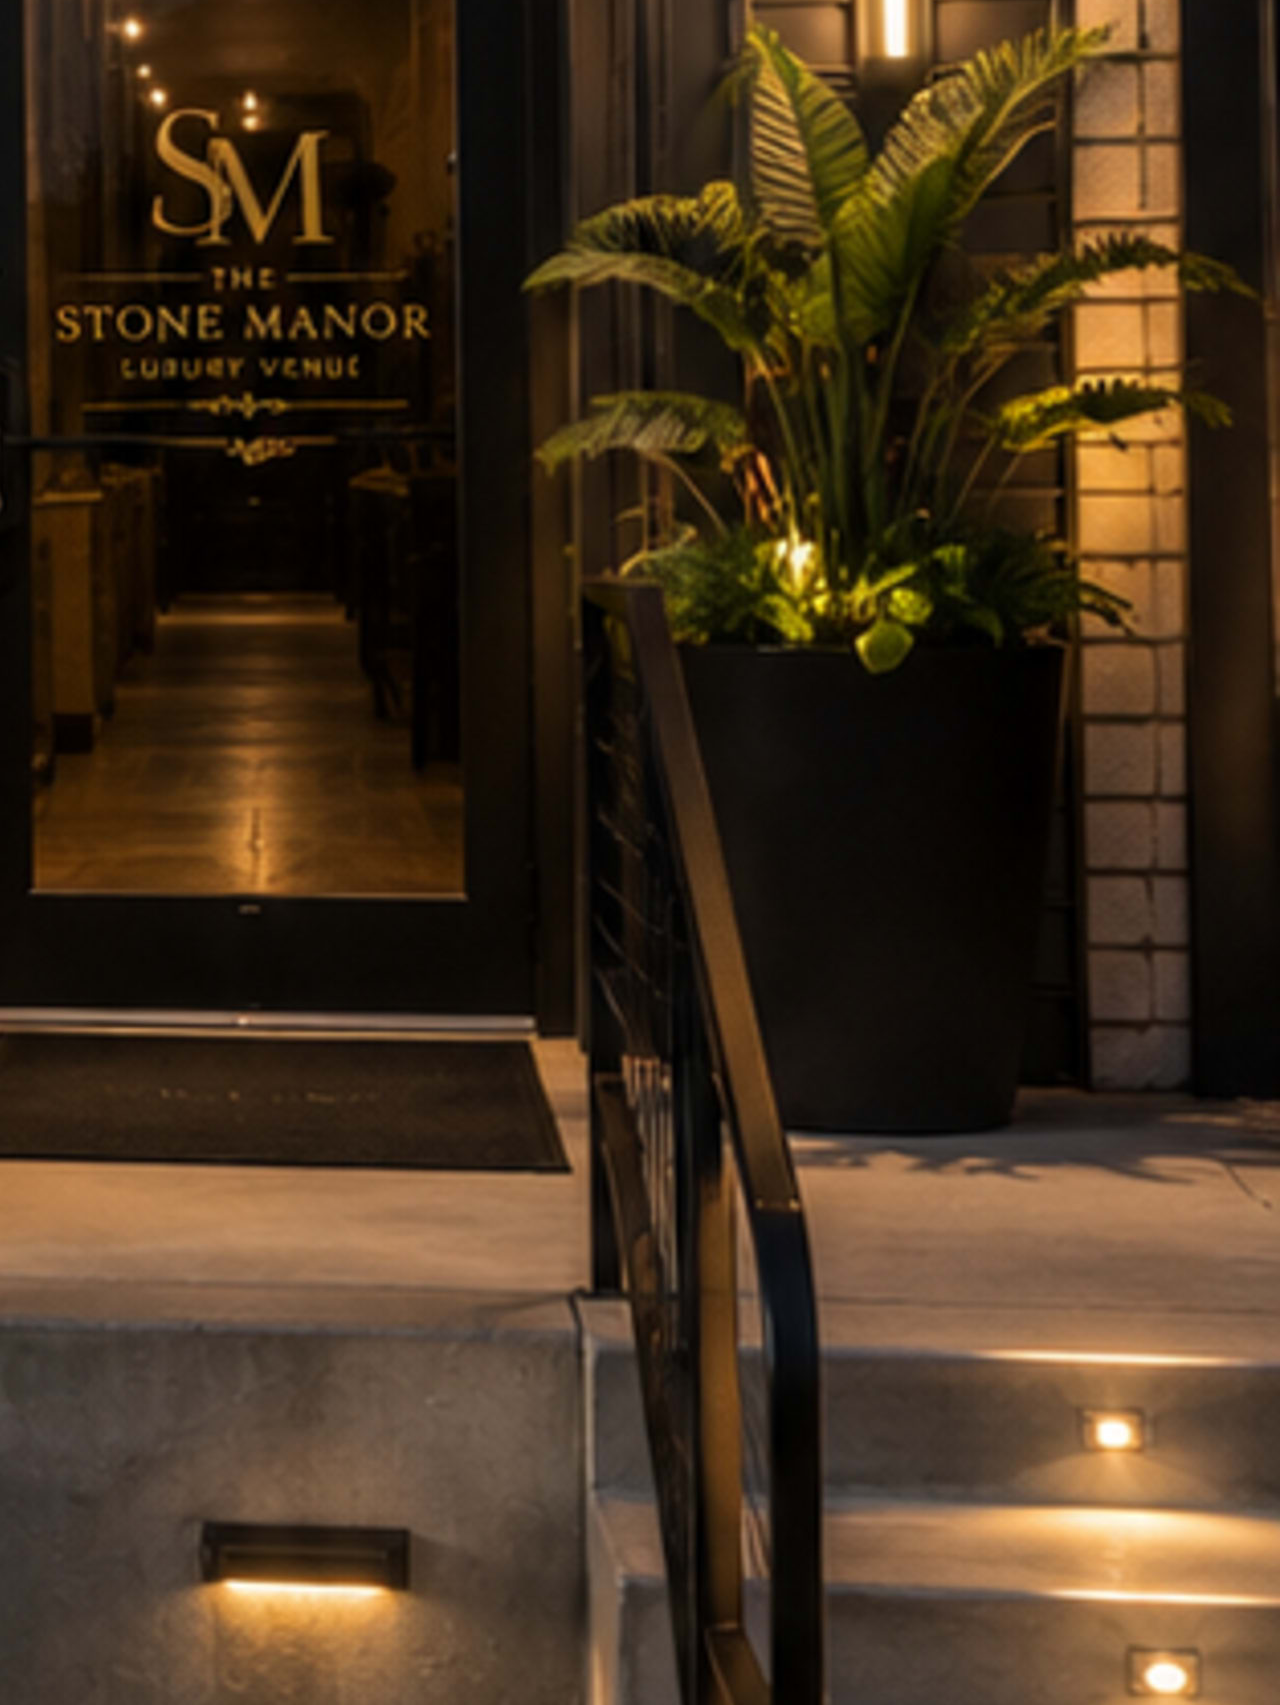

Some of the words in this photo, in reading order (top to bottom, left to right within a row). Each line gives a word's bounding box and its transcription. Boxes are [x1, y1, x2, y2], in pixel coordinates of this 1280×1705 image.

[151, 107, 335, 246] SM
[211, 267, 275, 291] THE
[55, 304, 225, 343] STONE
[244, 303, 431, 340] MANOR
